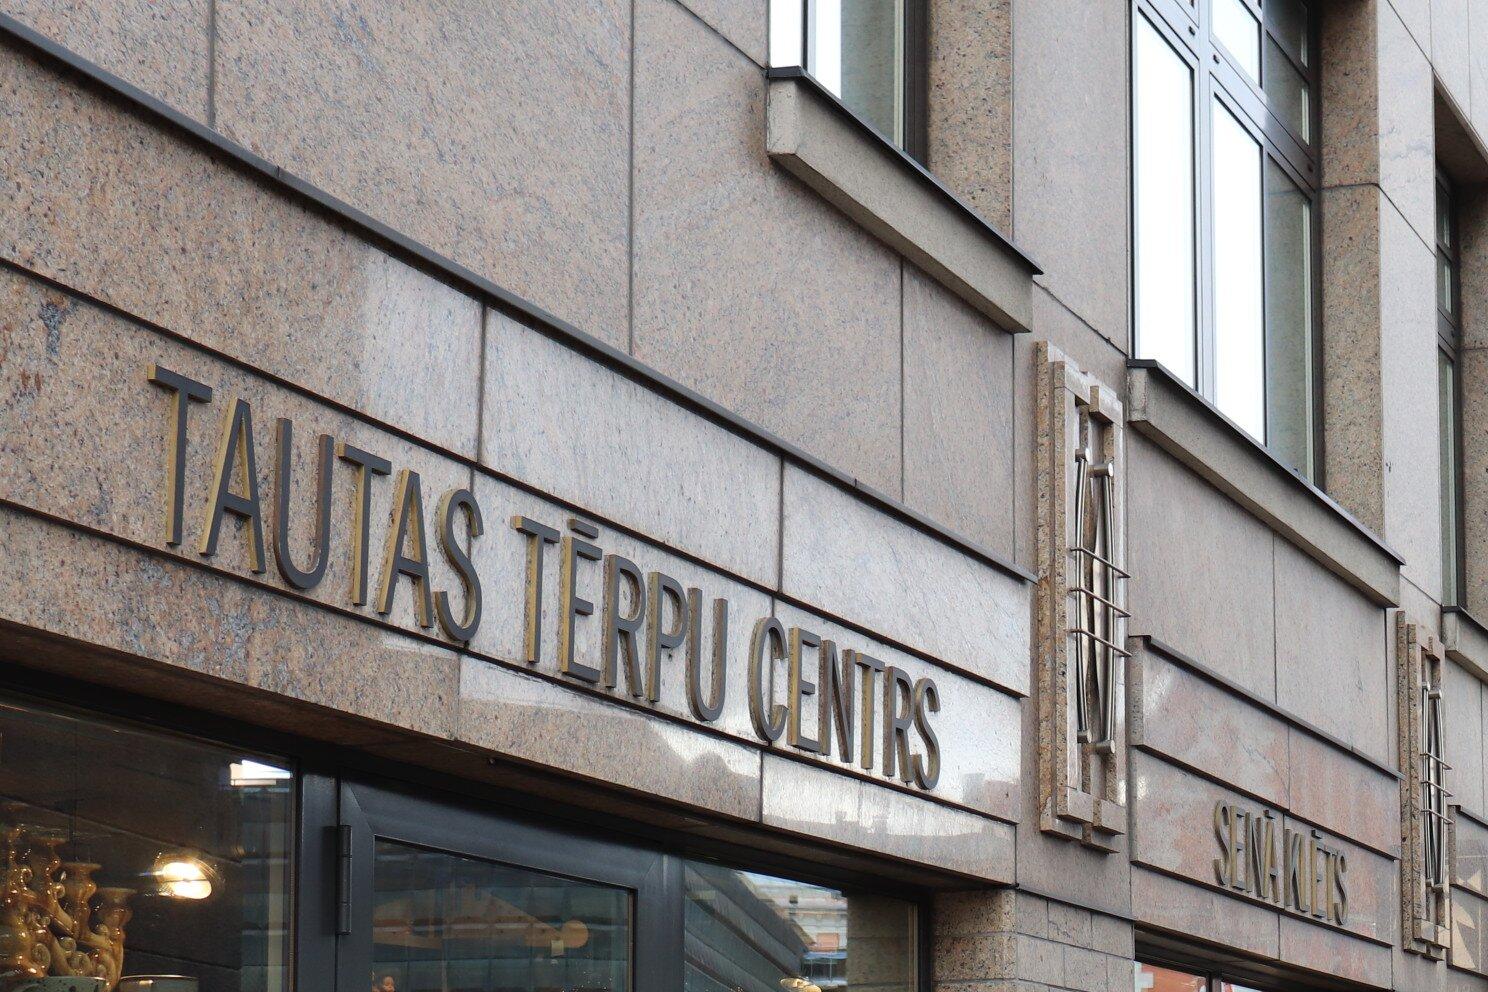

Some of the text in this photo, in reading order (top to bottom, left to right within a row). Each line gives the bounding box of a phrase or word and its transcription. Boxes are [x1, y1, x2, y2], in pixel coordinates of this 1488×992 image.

[147, 364, 940, 791] TAUTAS TĒRPU CENTRS
[1213, 800, 1348, 926] SENĀ KLĒTS
